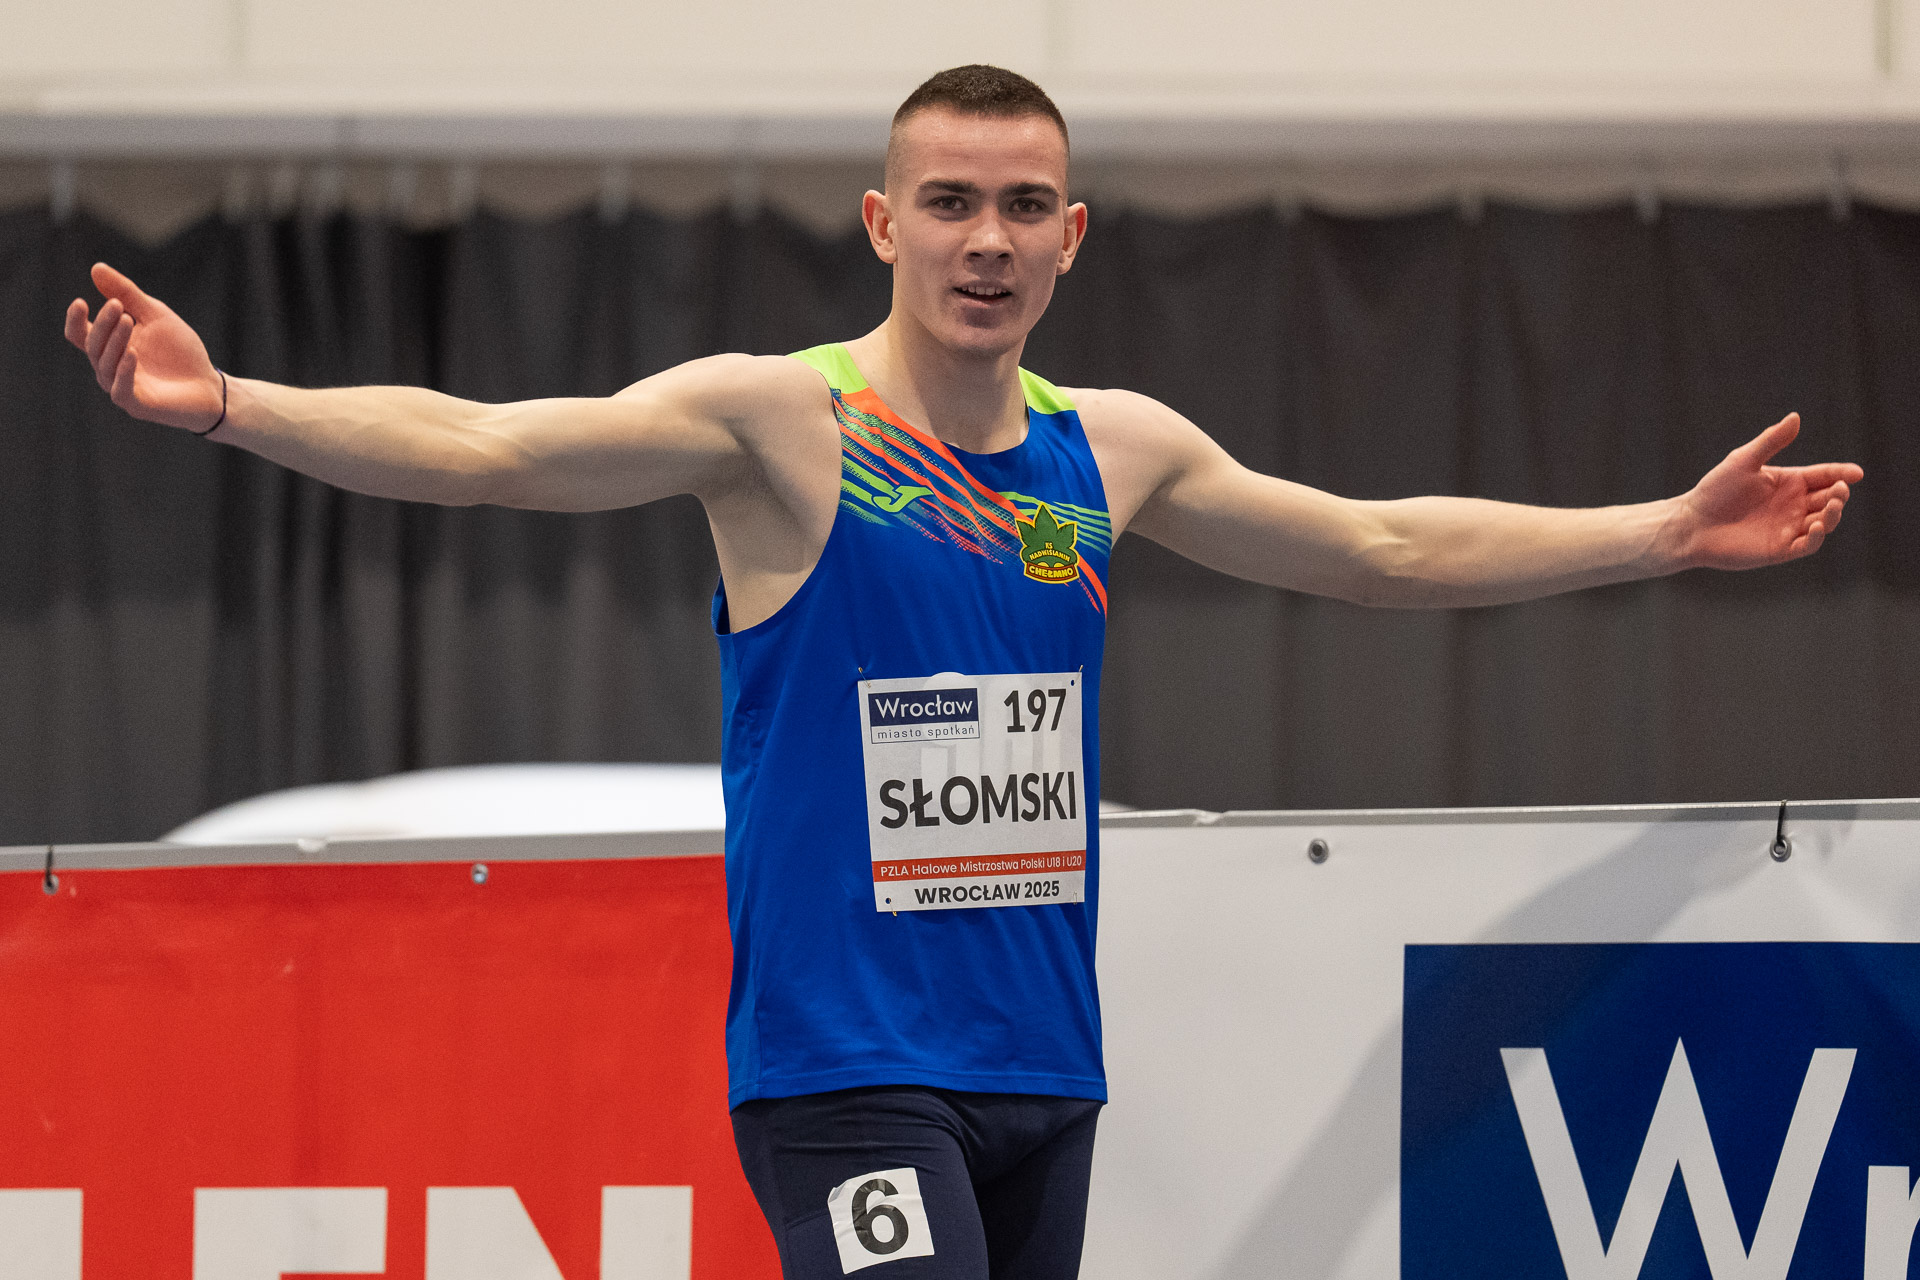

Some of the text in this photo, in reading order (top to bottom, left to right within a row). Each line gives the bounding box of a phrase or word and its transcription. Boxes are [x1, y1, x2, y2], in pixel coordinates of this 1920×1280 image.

[1028, 565, 1074, 578] CHEŁMNO
[875, 694, 973, 719] Wrocław
[1003, 688, 1067, 733] 197
[877, 724, 975, 740] miasto spotkań
[879, 771, 1077, 829] SŁOMSKI
[880, 865, 909, 877] PZLA
[912, 863, 957, 875] Halowe
[960, 859, 1019, 873] Mistrzostwa
[1021, 857, 1045, 870] Polski
[1046, 856, 1061, 868] U18
[1066, 855, 1082, 867] U20
[914, 880, 1060, 905] WROCŁAW 2025
[851, 1178, 909, 1255] 6
